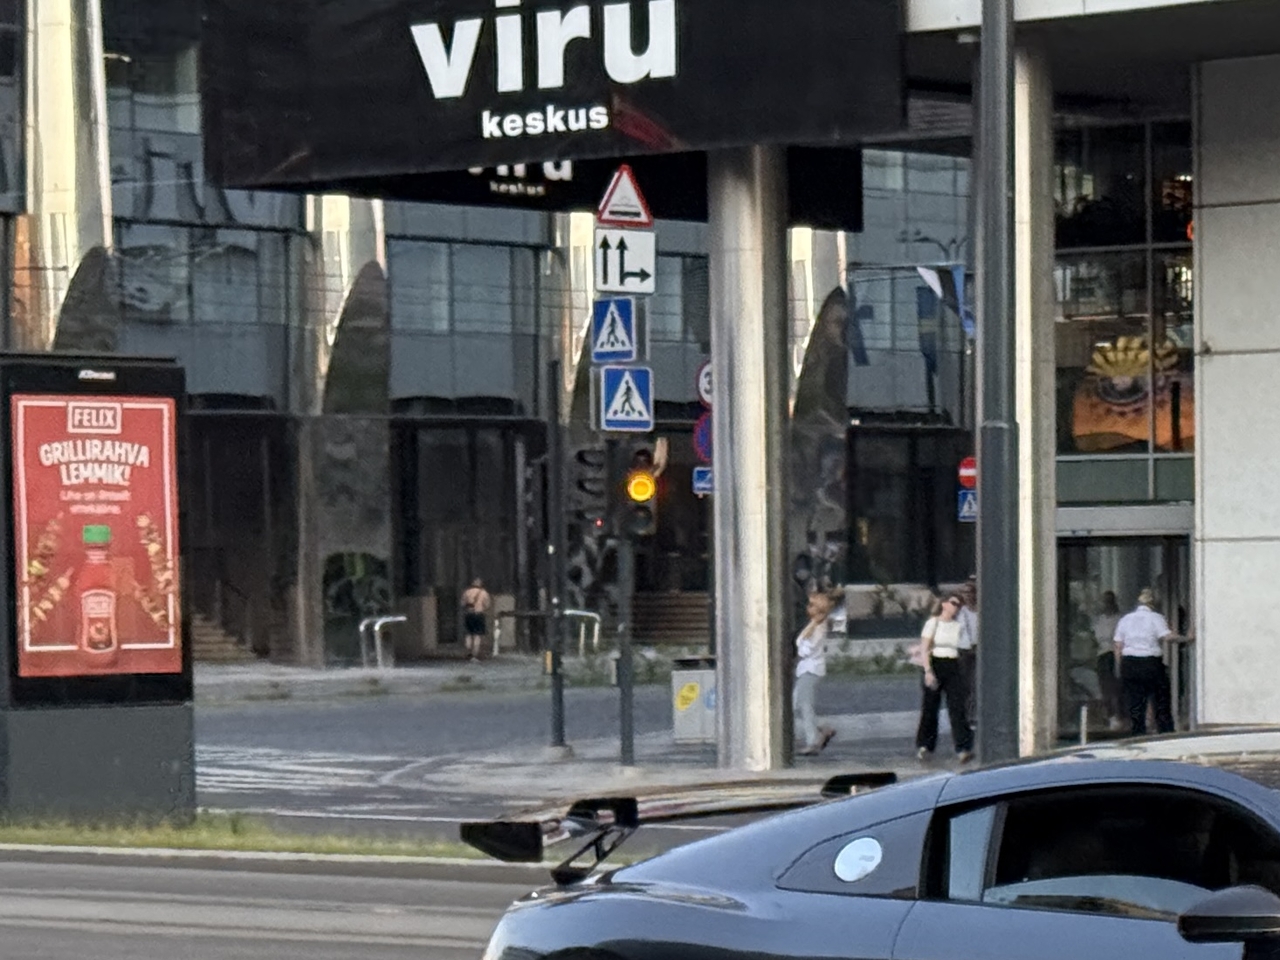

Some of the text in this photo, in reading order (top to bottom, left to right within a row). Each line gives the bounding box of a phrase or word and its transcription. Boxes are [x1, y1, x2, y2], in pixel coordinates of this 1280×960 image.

[410, 0, 677, 99] viru
[482, 105, 609, 138] keskus
[73, 408, 115, 427] FELIX
[39, 439, 150, 468] GRILLIRAHVA
[60, 462, 131, 486] LEMMIK!
